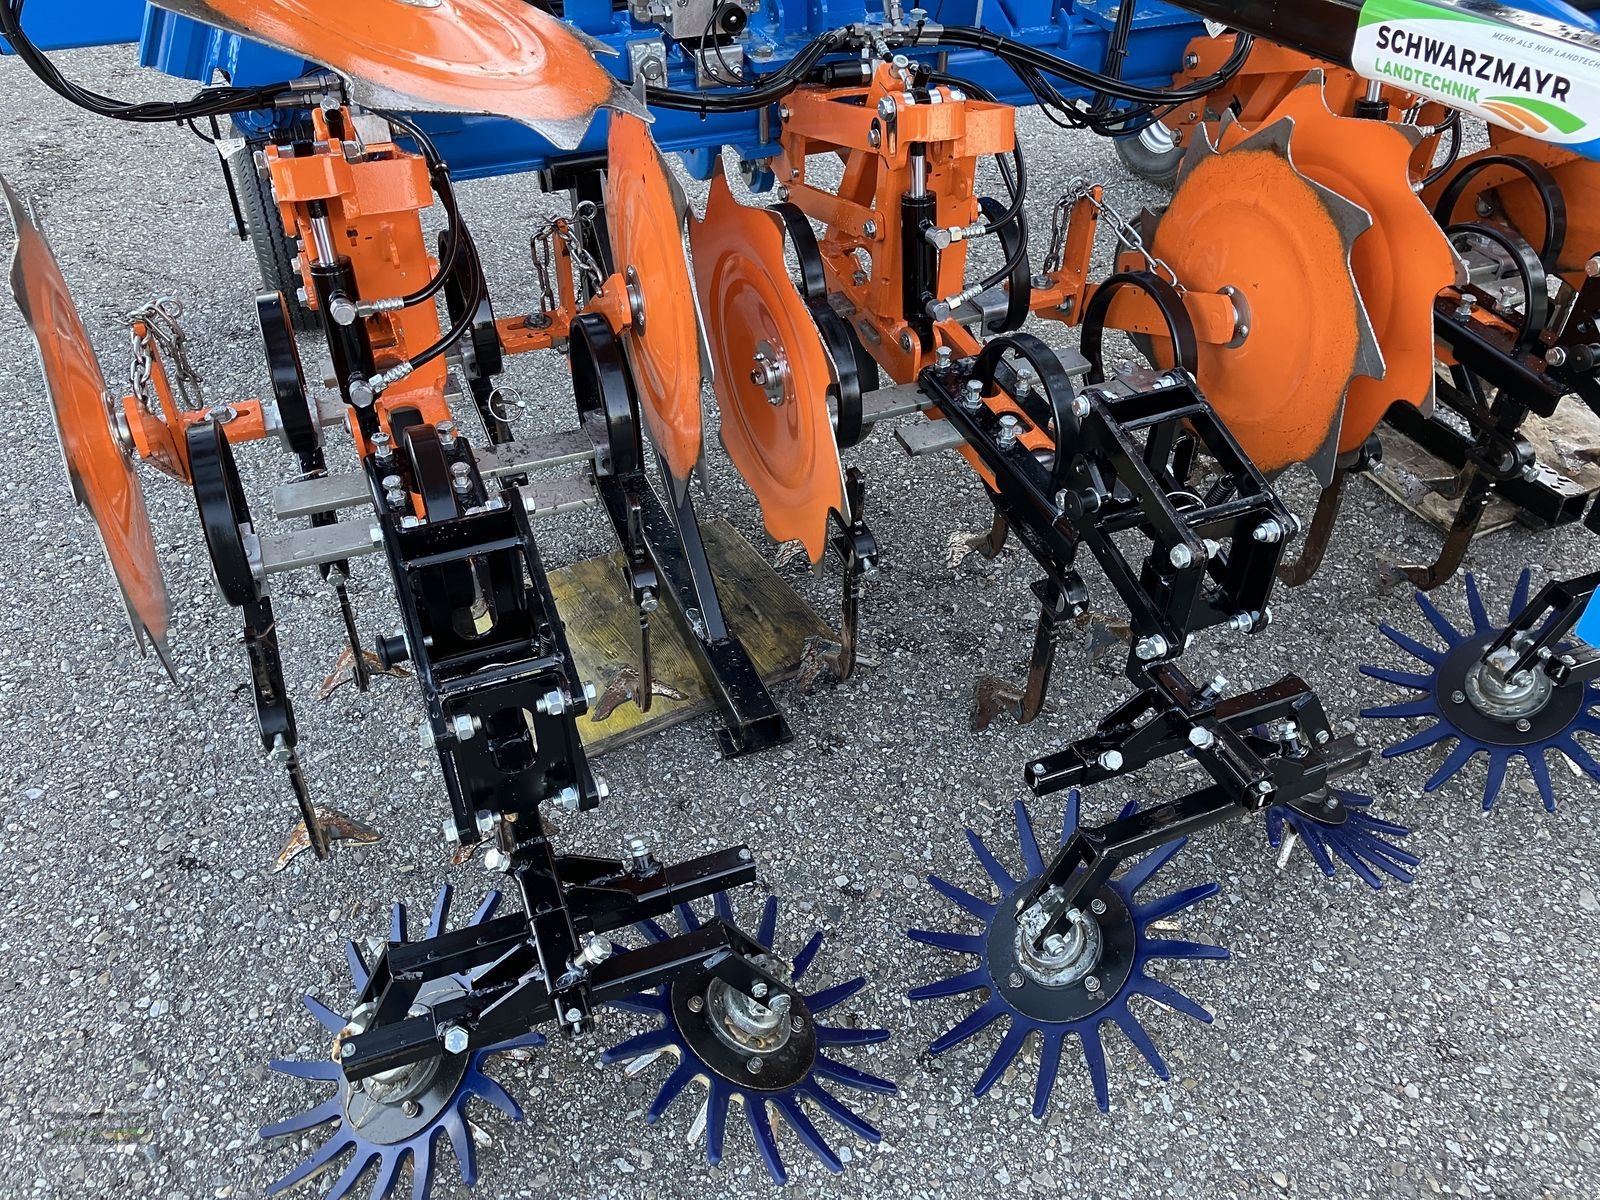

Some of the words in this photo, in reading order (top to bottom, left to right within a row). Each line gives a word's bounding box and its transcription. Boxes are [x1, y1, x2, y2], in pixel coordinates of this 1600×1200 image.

[1376, 26, 1571, 102] SCHWARZMAYR
[1492, 32, 1516, 42] MEHR
[1516, 40, 1533, 48] ALS
[1535, 45, 1554, 54] NUR
[1376, 58, 1480, 103] LANDTECHNIK
